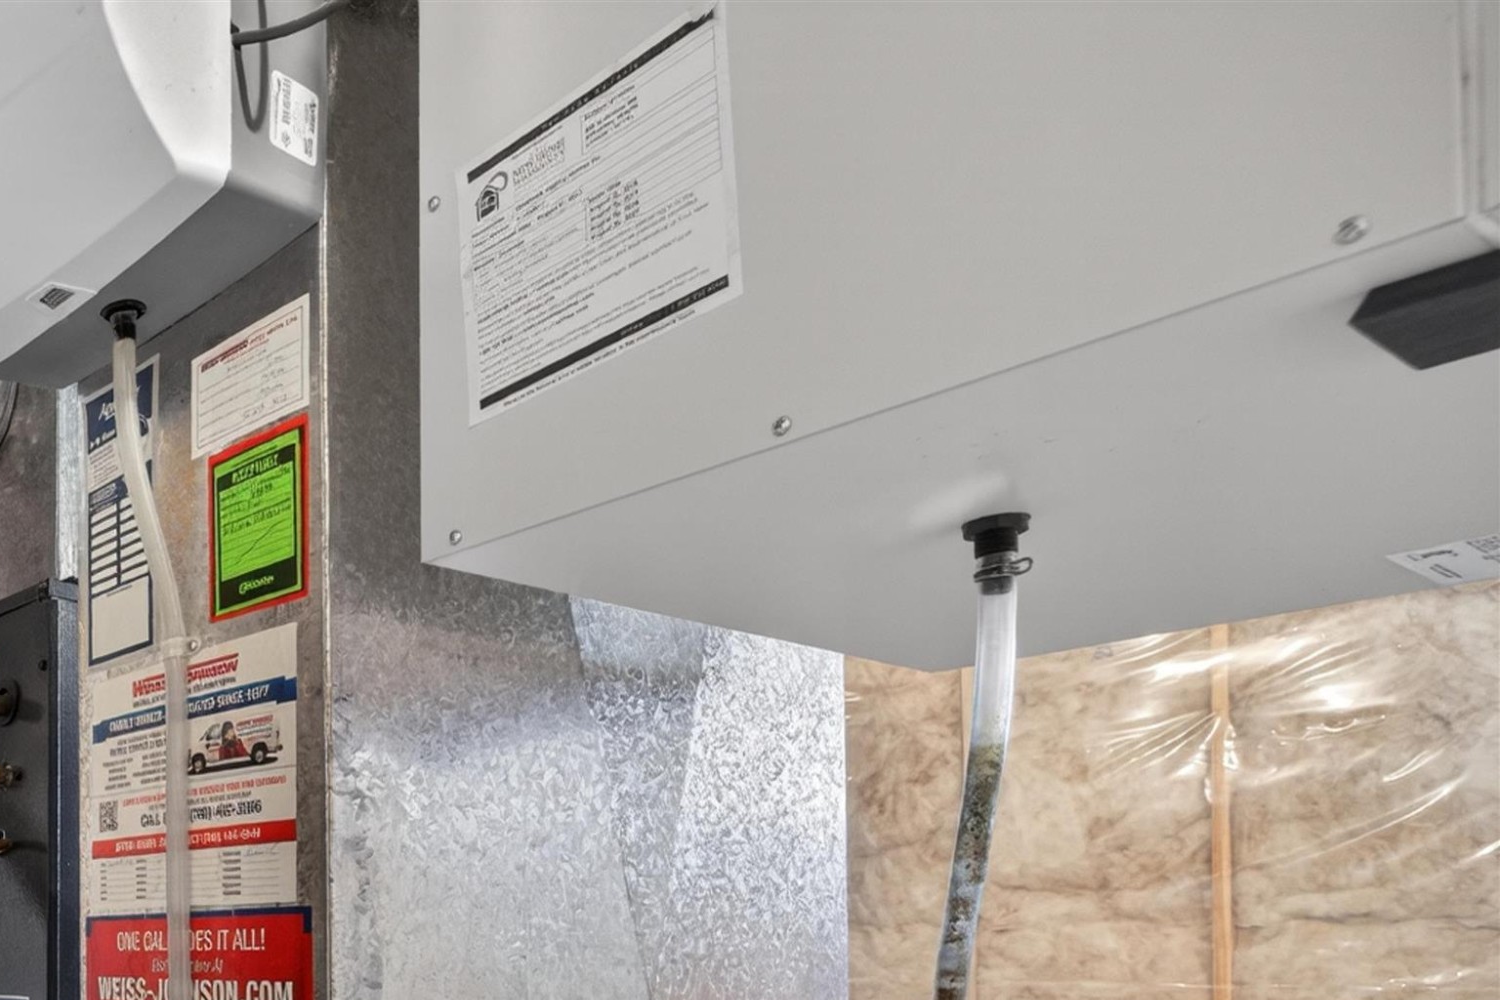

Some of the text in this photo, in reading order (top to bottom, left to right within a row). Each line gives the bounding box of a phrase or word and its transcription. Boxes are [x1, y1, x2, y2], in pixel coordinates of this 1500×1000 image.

[117, 931, 141, 951] ONE
[143, 930, 169, 951] CAL
[216, 929, 230, 951] IT
[232, 927, 266, 951] ALL!
